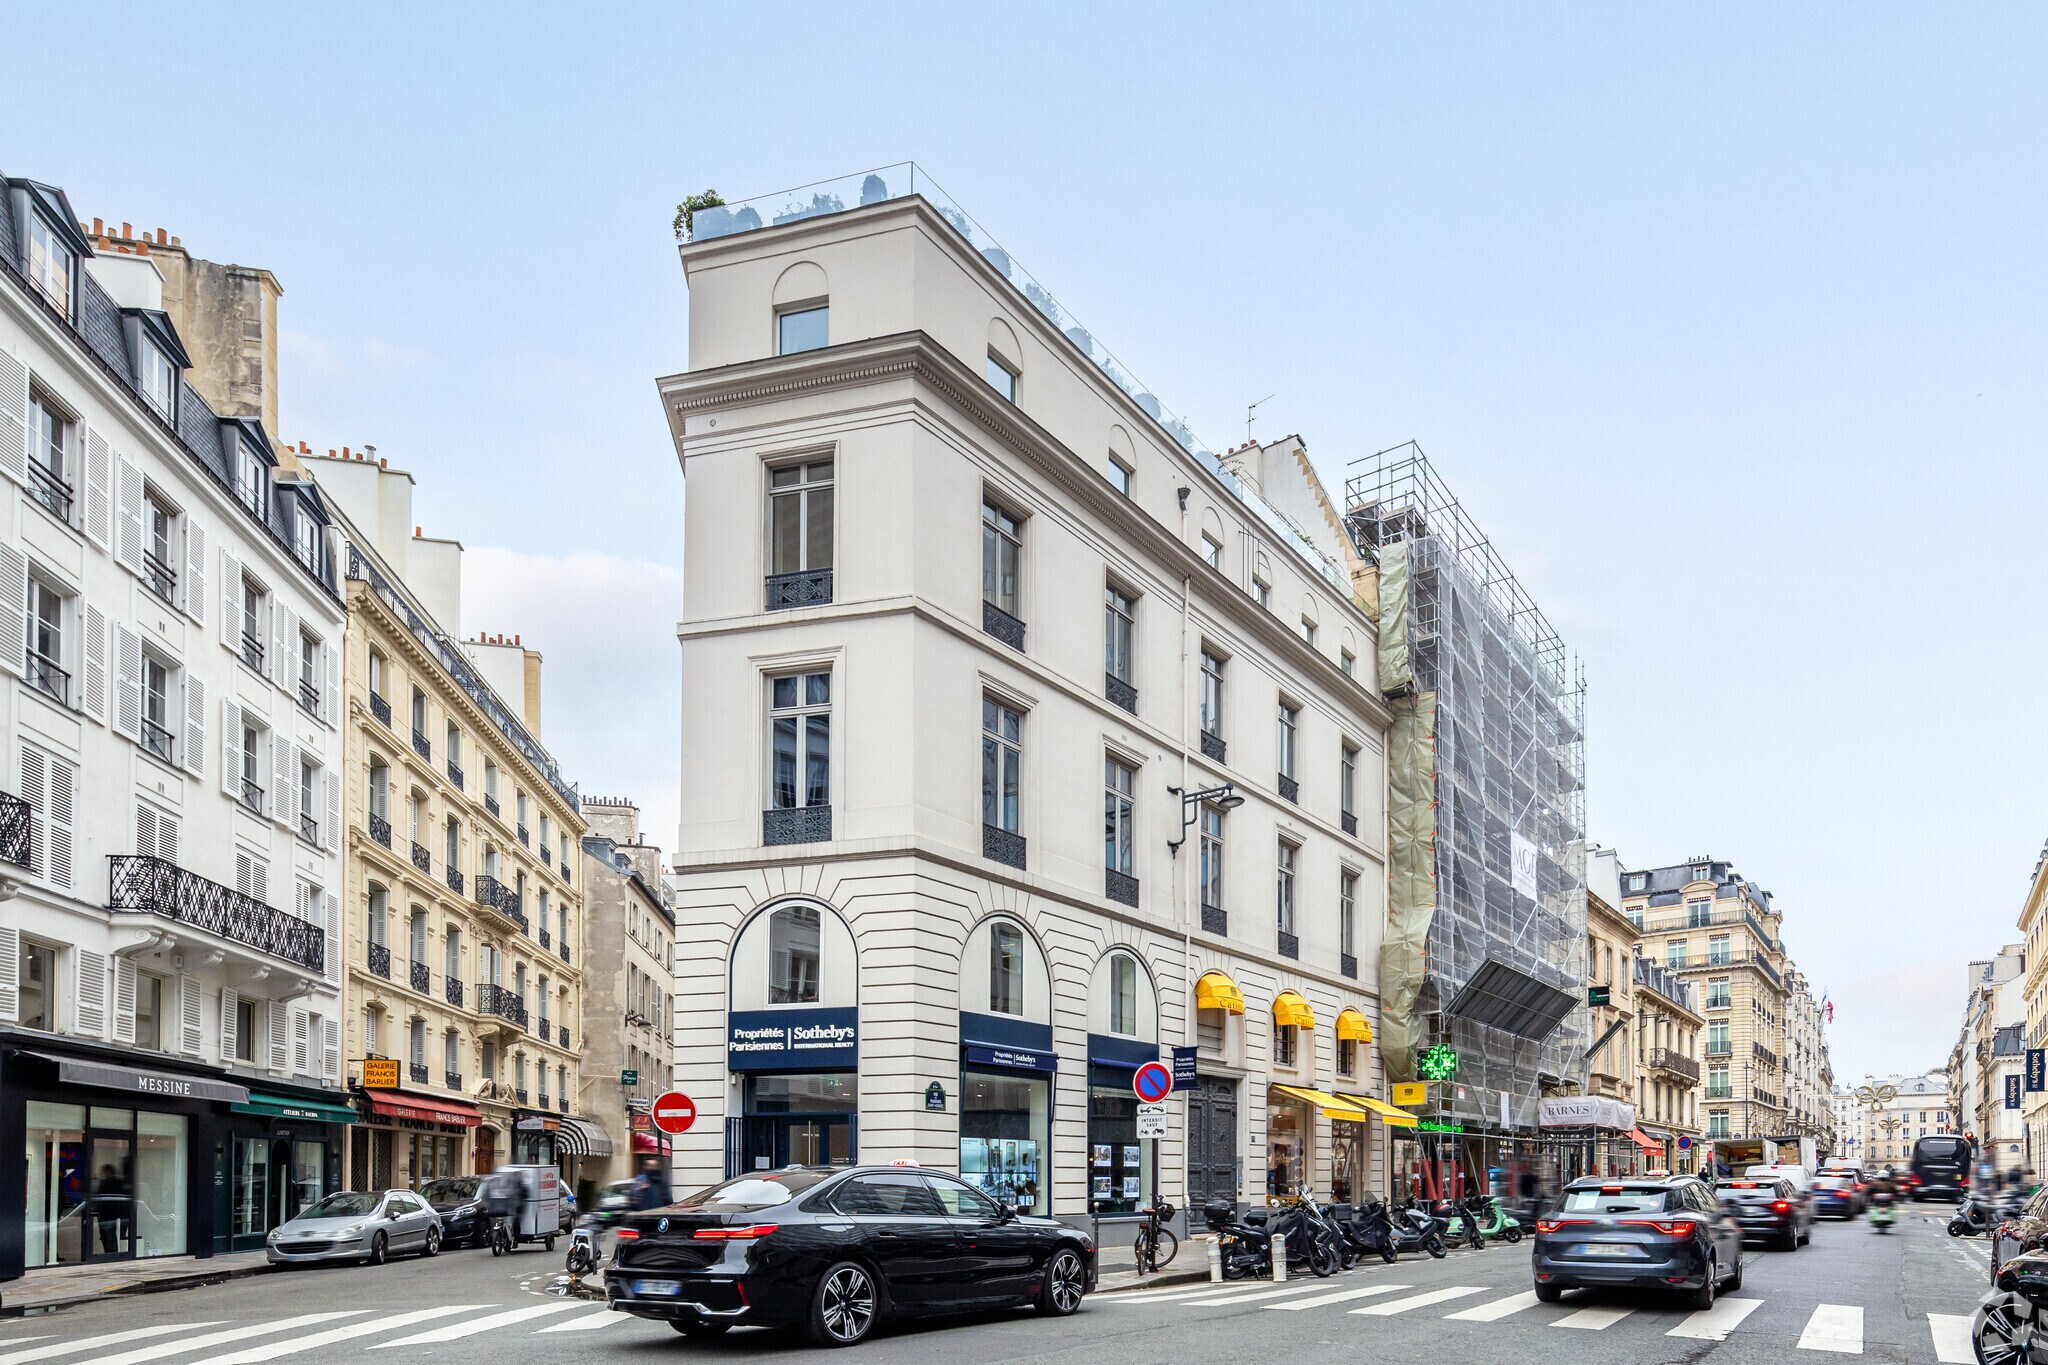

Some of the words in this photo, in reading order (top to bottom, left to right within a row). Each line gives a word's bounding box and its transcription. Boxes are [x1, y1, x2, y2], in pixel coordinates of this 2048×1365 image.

[734, 1027, 785, 1040] Propriétés
[793, 1025, 855, 1041] Sotheby's
[729, 1041, 785, 1052] Parisiennes
[1015, 1054, 1036, 1063] Sotheby's
[2030, 1052, 2041, 1084] Sotheby's
[138, 1077, 190, 1095] MESSINE
[2009, 1077, 2017, 1103] Sotheby's
[397, 1108, 416, 1118] GALERIE
[435, 1112, 450, 1122] FRANCIS
[451, 1114, 466, 1124] BARLIER
[1548, 1105, 1590, 1116] BARNES
